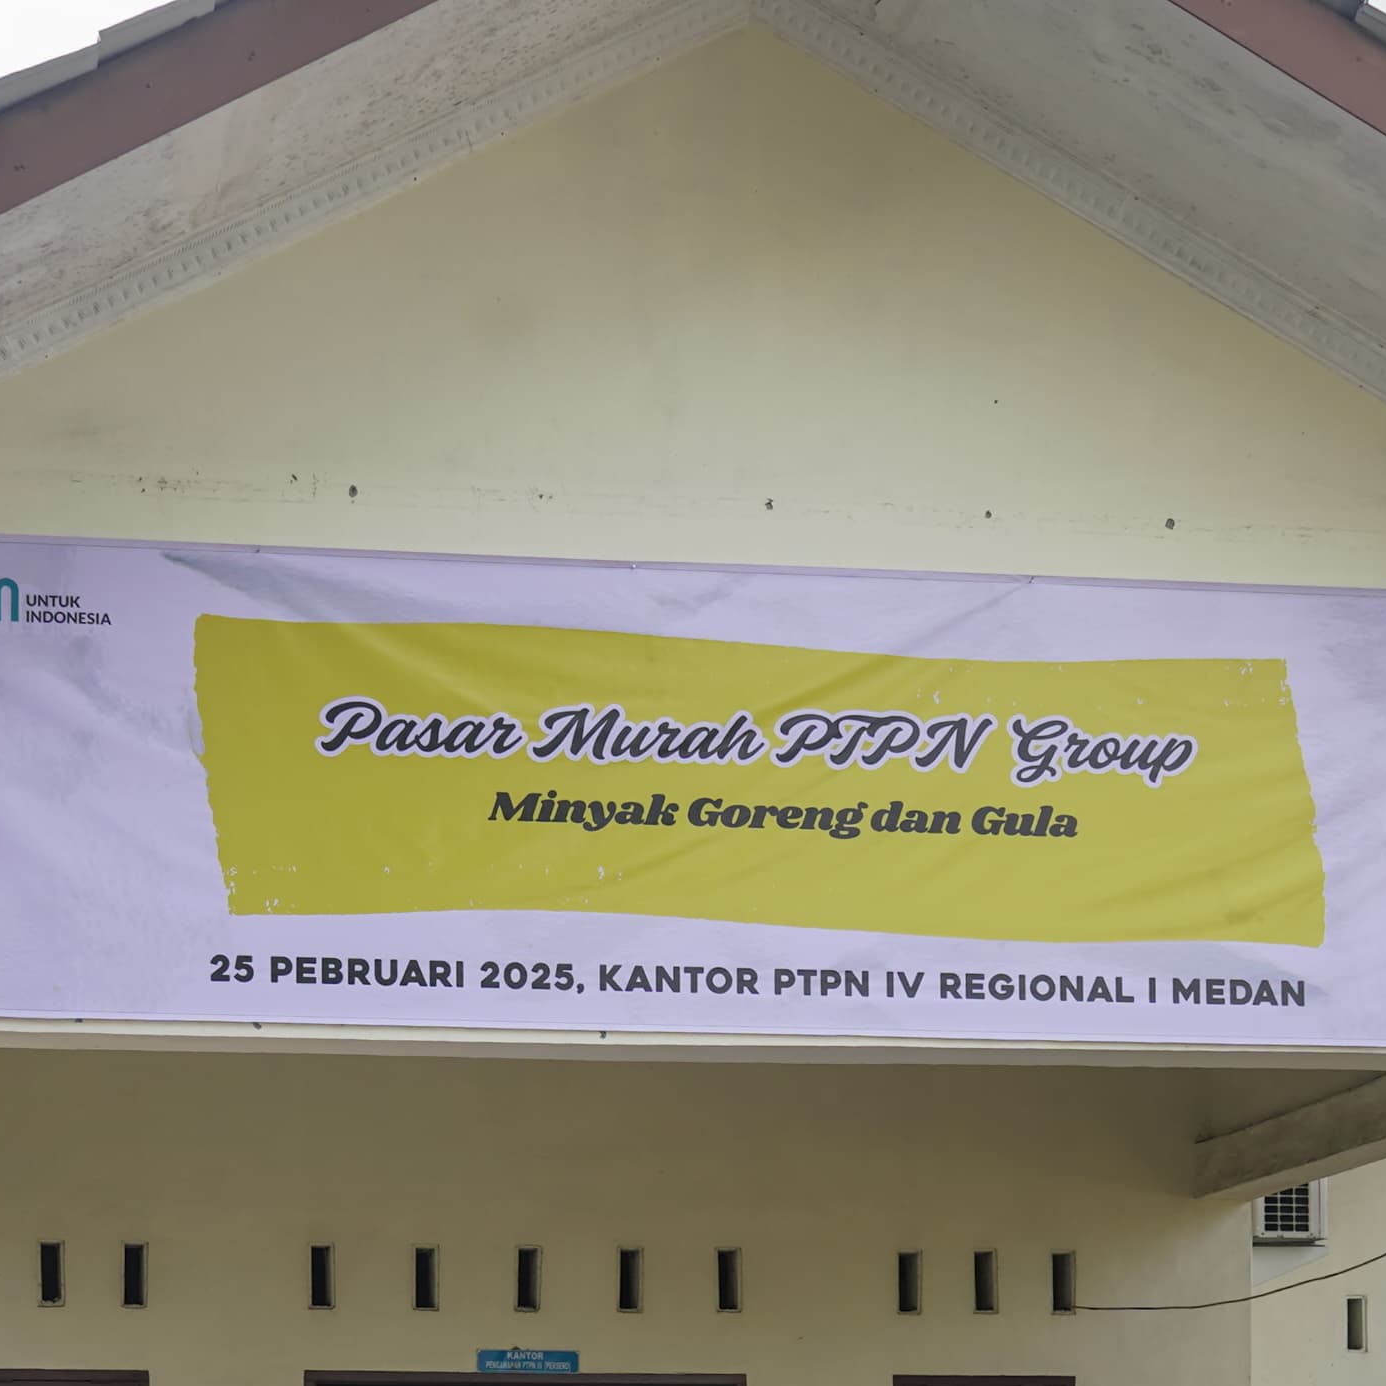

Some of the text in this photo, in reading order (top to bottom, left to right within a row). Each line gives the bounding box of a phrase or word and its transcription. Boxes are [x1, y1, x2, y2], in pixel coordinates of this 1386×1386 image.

[25, 594, 81, 608] UNTUK
[25, 610, 112, 626] INDONESIA
[320, 700, 1193, 784] Pasar Murah PTPN Group
[487, 789, 1079, 840] Minyak Goreng dan Gula
[210, 954, 1305, 1007] 25 PEBRUARI 2025, KANTOR PTPN IV REGIONAL I MEDAN
[507, 1351, 544, 1360] KANTOR
